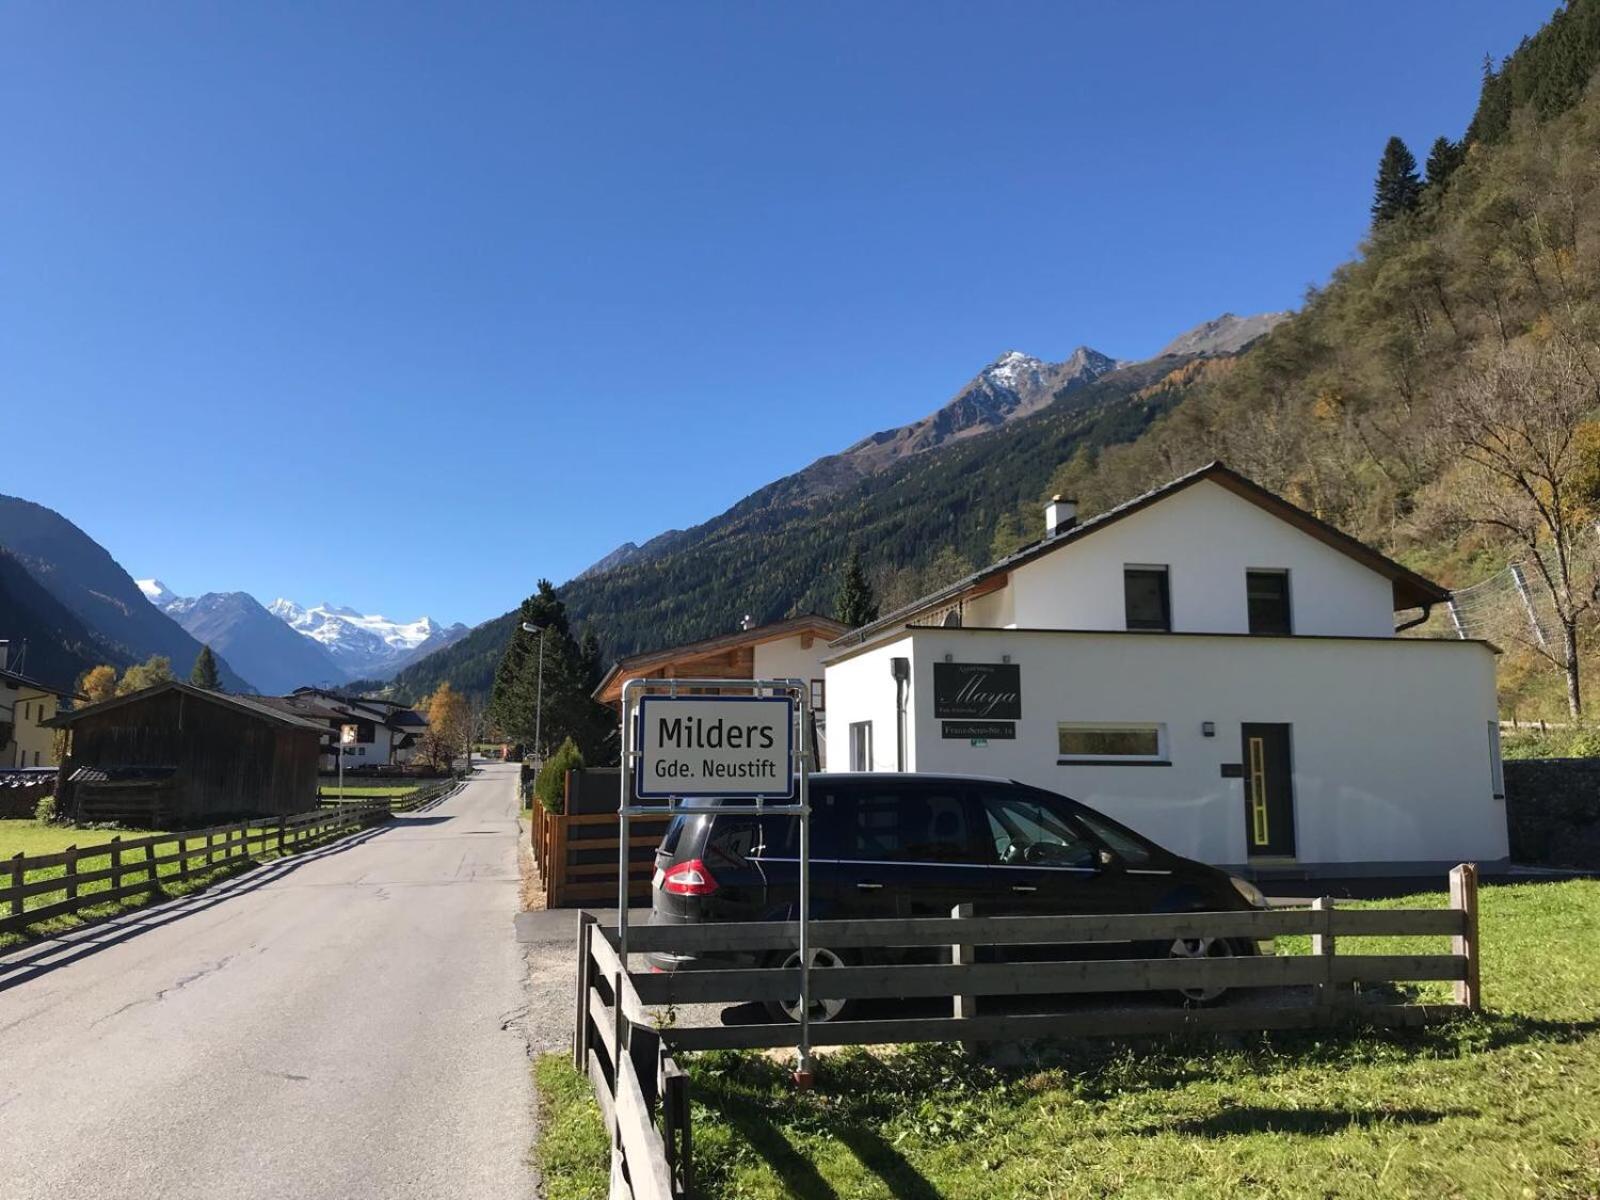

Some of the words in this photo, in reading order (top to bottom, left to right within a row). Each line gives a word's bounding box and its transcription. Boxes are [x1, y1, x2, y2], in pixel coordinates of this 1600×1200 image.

[938, 674, 1016, 717] Maya
[658, 716, 774, 748] Milders
[655, 759, 695, 777] Gde.
[702, 758, 776, 777] Neustift
